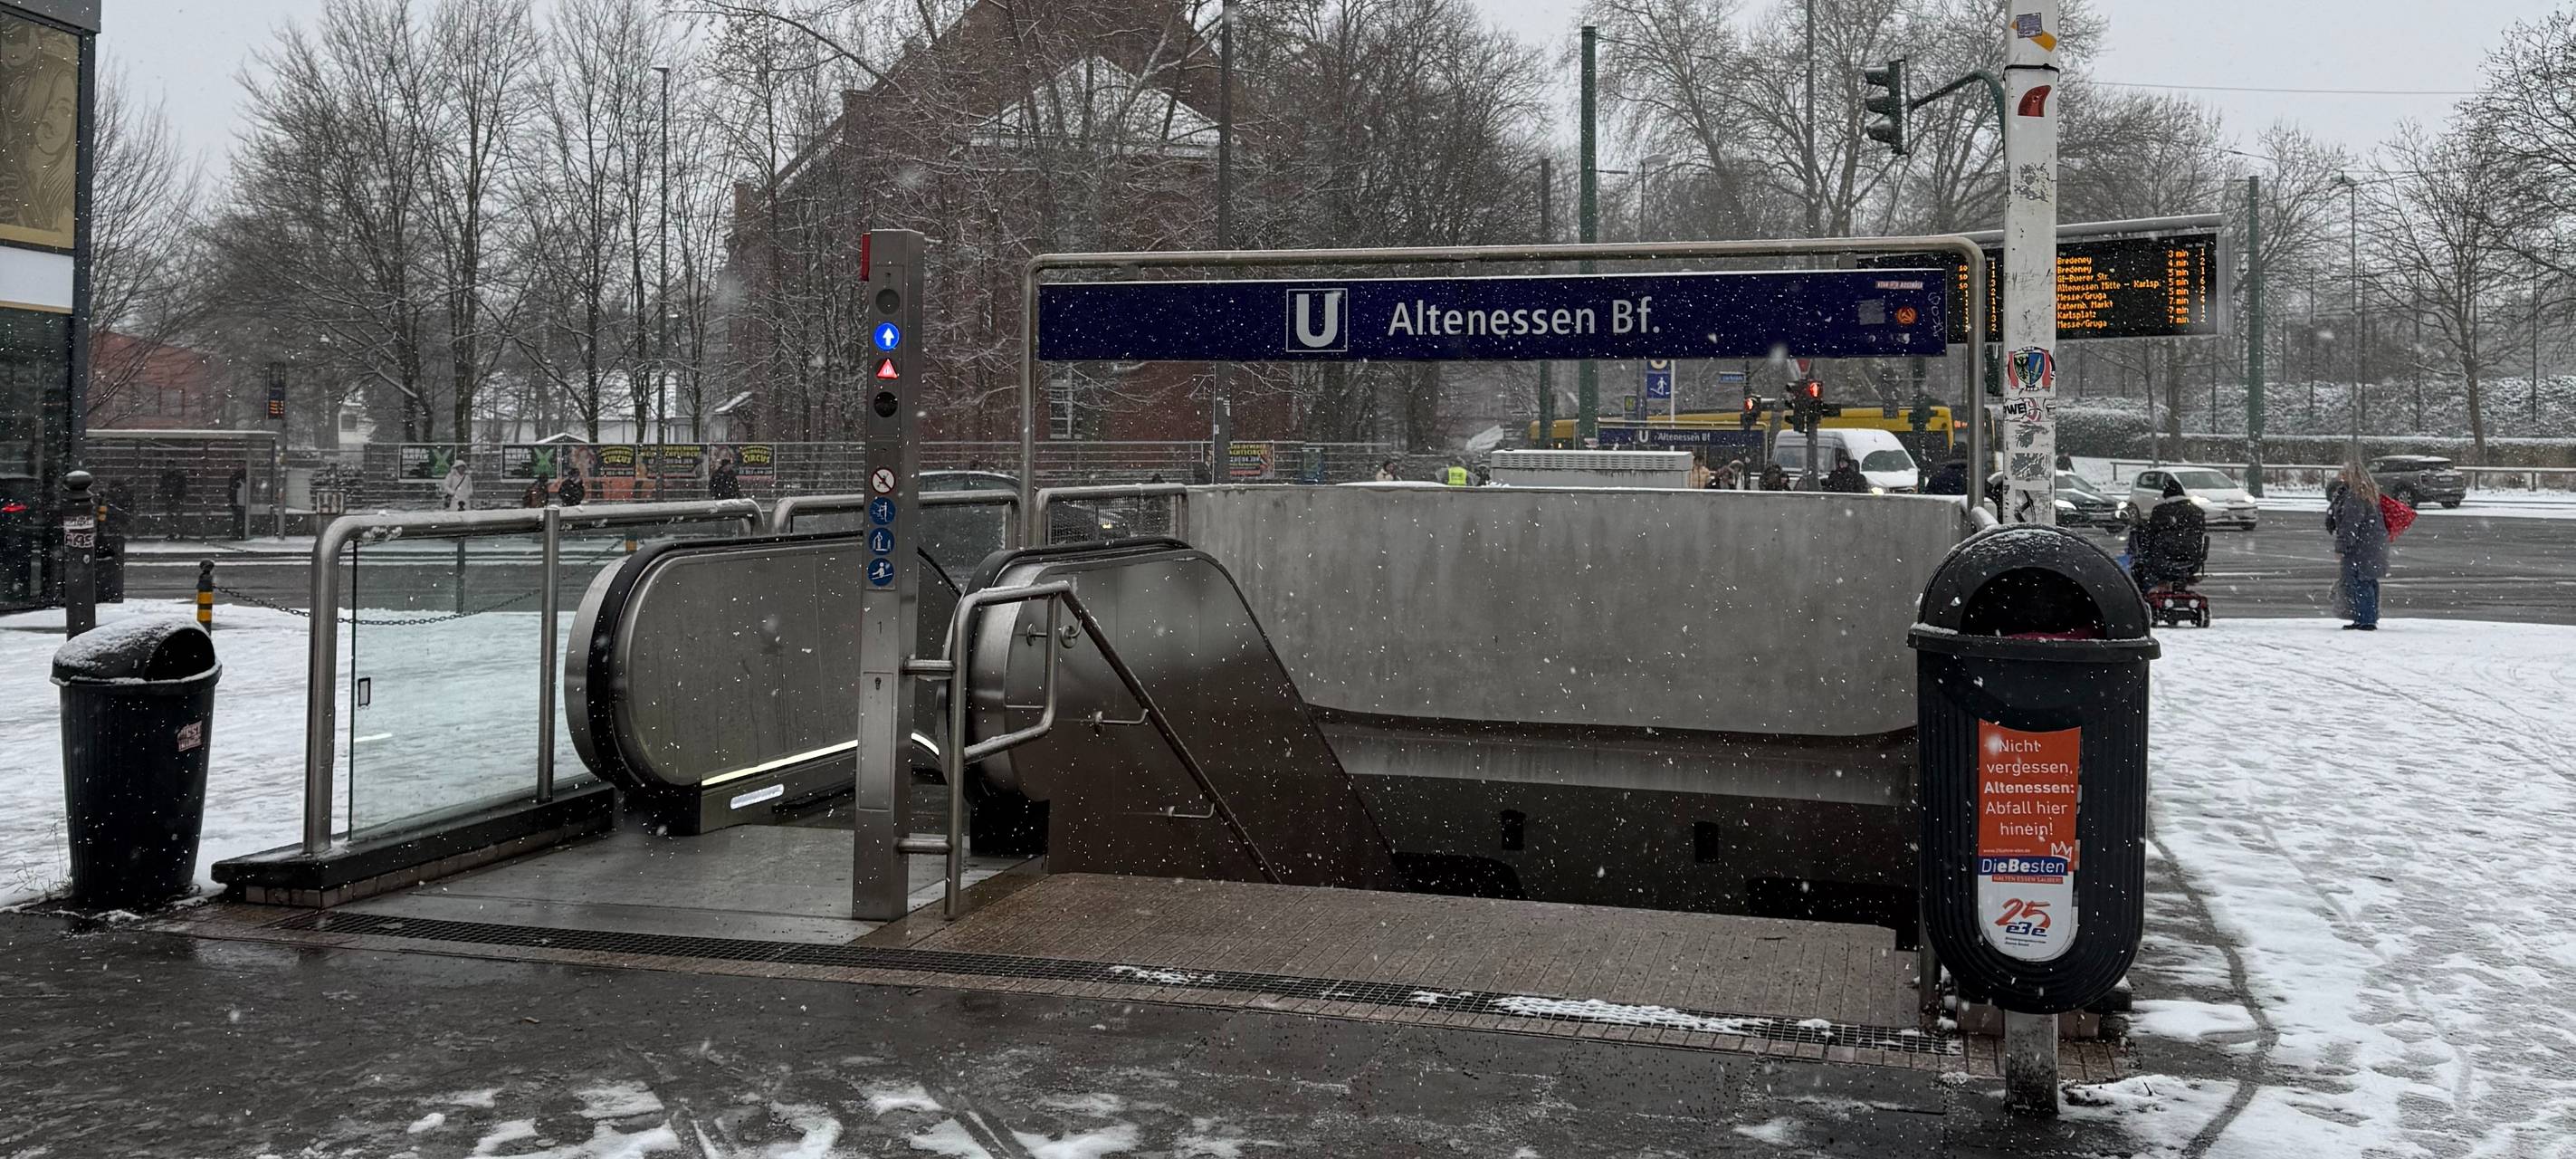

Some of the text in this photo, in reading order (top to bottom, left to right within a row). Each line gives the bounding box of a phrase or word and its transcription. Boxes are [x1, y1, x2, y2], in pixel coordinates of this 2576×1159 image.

[2175, 249, 2189, 257] min
[2200, 257, 2205, 265] 2
[2057, 284, 2099, 292] Altenessen
[2168, 278, 2174, 286] 5
[2057, 292, 2107, 301] Messe/Gruga
[2168, 287, 2174, 295] 5
[2175, 287, 2189, 295] min
[2091, 300, 2113, 308] Markt
[1296, 293, 1660, 348] U Altenessen Bf.
[2057, 310, 2096, 320] Karlsplatz
[2057, 320, 2107, 329] Messe/Gruga
[2175, 315, 2189, 324] min
[1639, 431, 1648, 442] U
[1658, 431, 1699, 442] Altenessen
[743, 455, 770, 463] CIRCUS
[877, 621, 882, 634] 1
[1999, 740, 2039, 752] Nicht
[1984, 782, 2074, 794] Altenessen:
[1985, 801, 2068, 814] Abfall hier
[2000, 822, 2053, 835] hinein!
[1982, 859, 2064, 873] DieBesten
[1994, 898, 2051, 928] 25
